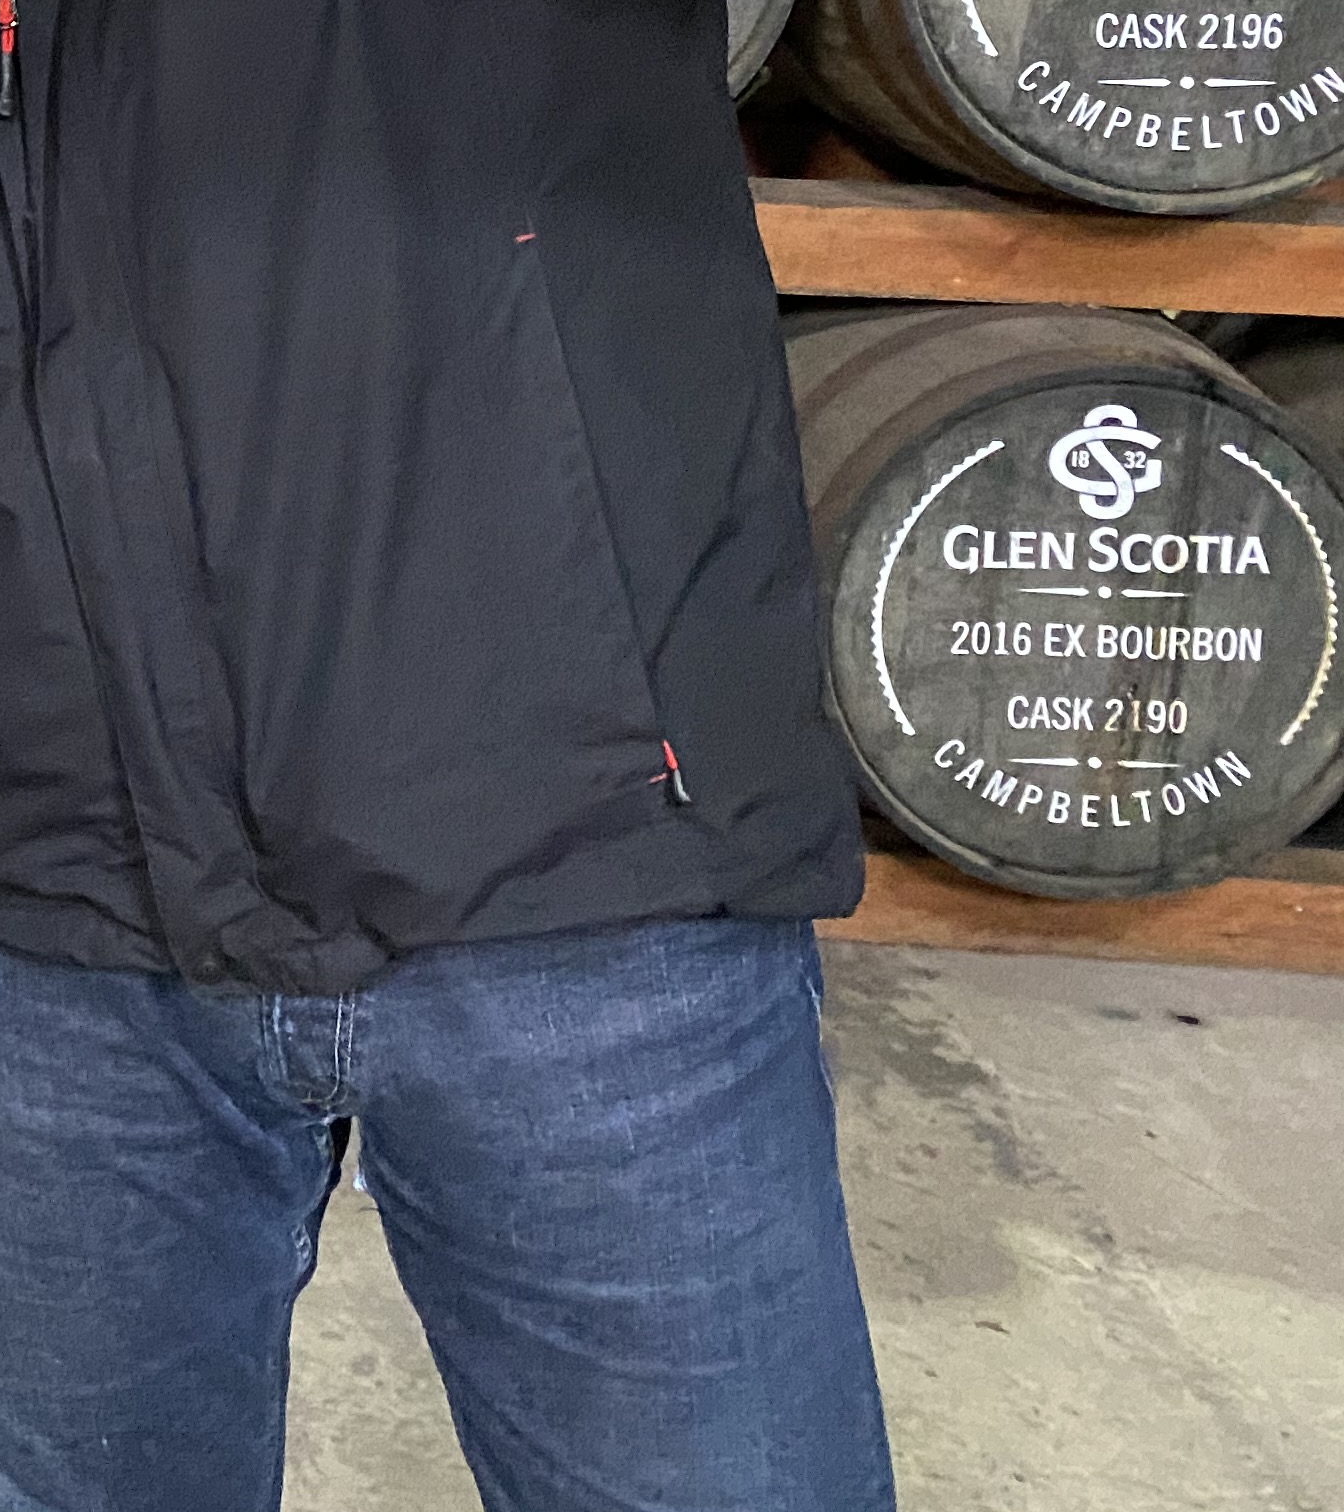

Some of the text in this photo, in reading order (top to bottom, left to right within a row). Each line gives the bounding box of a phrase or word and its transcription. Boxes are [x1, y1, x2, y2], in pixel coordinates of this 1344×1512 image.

[1095, 13, 1283, 49] CASK 2196
[1017, 60, 1344, 151] CAMPBELTOWN
[1071, 450, 1146, 469] 18 32
[943, 525, 1270, 575] GLEN SCOTIA
[951, 621, 1263, 661] 2016 EX BOURBON
[1008, 696, 1187, 734] CASK 2190
[934, 738, 1252, 827] CAMPBELTOWN
